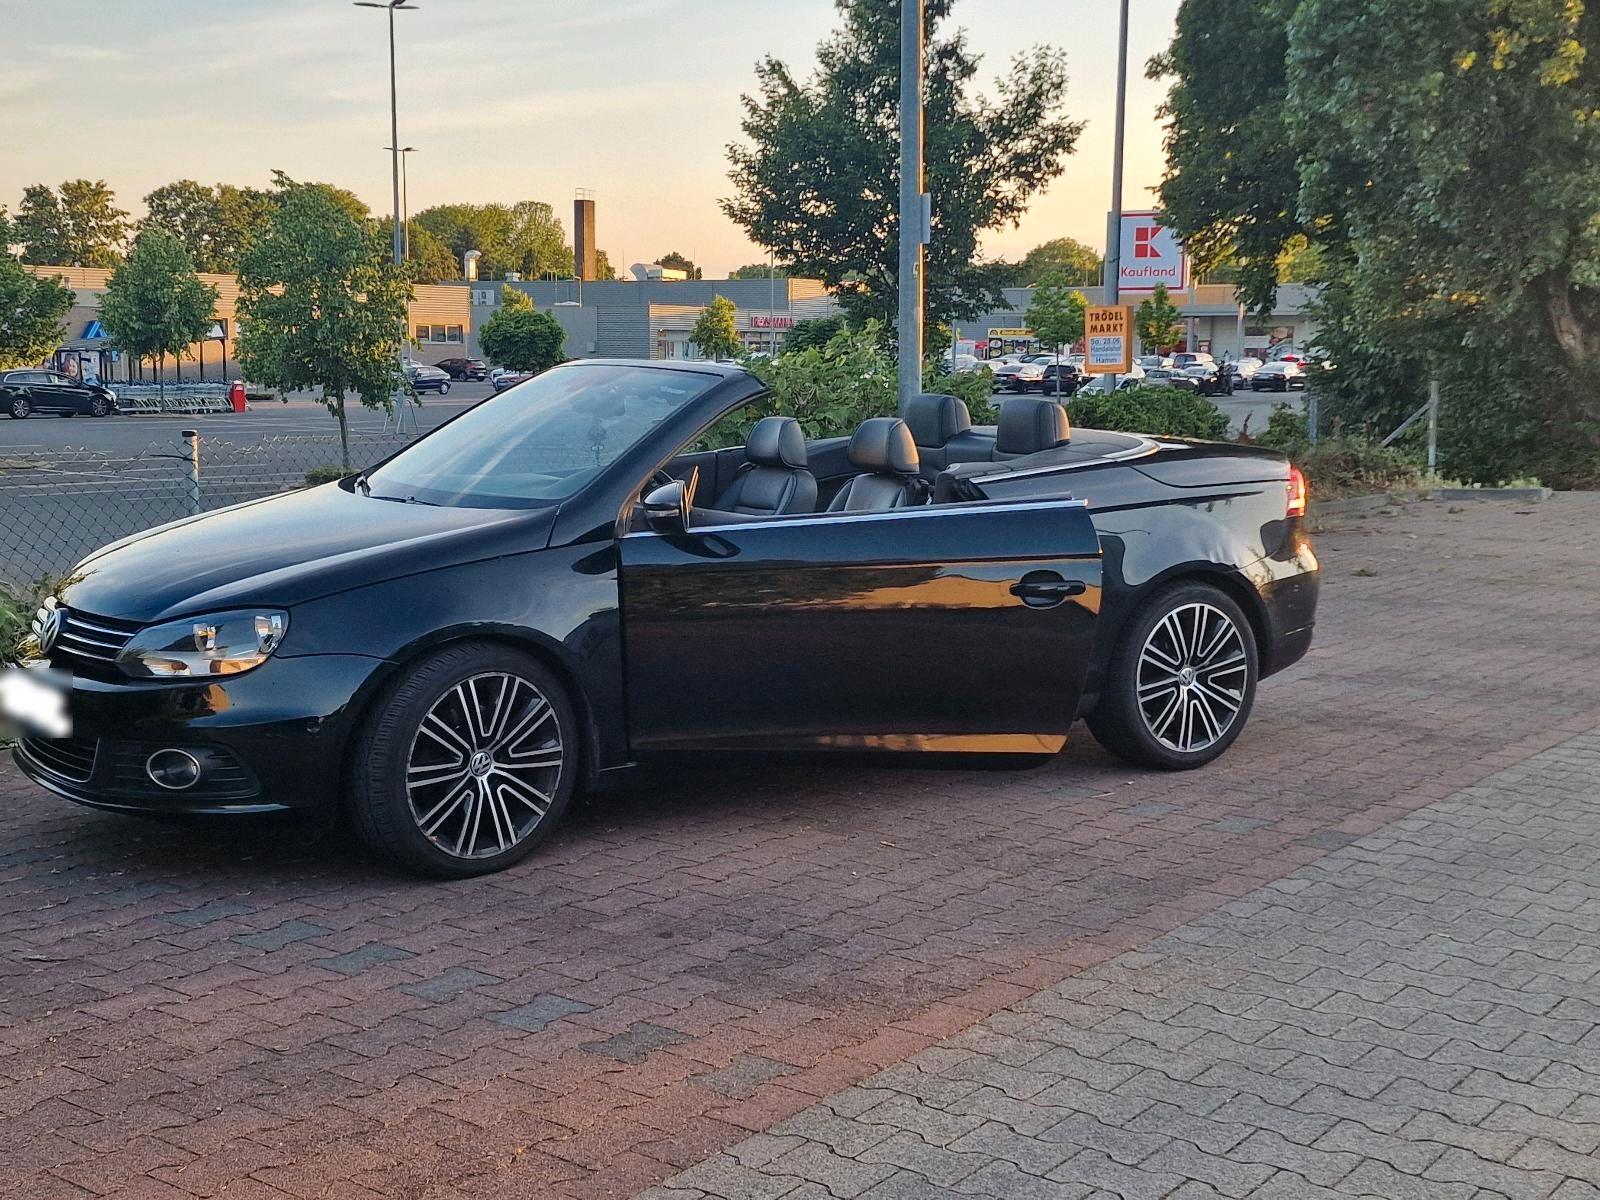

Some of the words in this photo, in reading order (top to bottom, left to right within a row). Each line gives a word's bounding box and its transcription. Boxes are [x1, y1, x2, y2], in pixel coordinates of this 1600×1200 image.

[1120, 264, 1176, 277] Kaufland
[1089, 309, 1124, 321] TRÖDEL
[1089, 323, 1123, 333] MARKT
